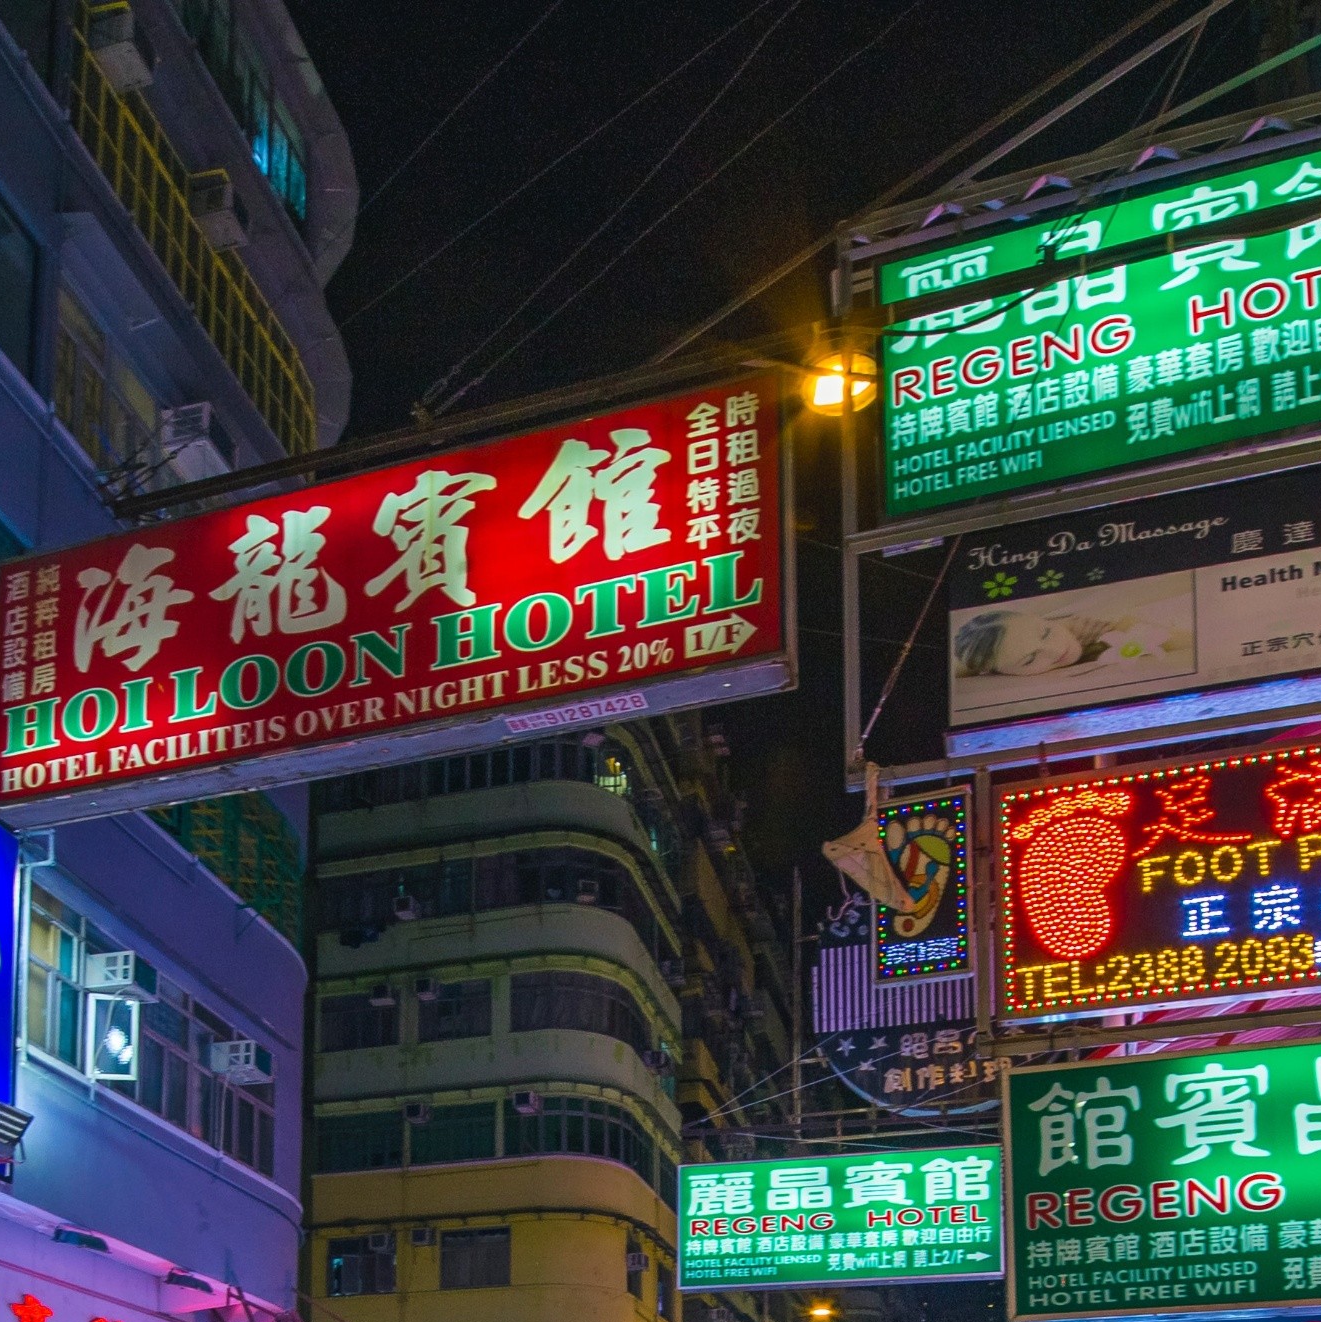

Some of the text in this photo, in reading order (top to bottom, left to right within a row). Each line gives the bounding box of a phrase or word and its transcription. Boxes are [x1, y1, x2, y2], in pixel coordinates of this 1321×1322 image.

[892, 313, 1135, 408] REGENG
[686, 401, 721, 552] 全日特平
[726, 390, 763, 545] 時租過夜
[893, 450, 1044, 500] HOTEL FREE WIFI
[894, 450, 952, 478] HOTEL
[955, 429, 1034, 465] FACILITY
[73, 427, 672, 675] 海龍賓館
[1048, 531, 1093, 557] Da
[1098, 513, 1231, 548] Massage
[1220, 563, 1304, 593] Health
[0, 570, 31, 703] 酒店設備
[1, 551, 765, 757] HOI LOON HOTEL
[32, 563, 60, 696] 純粹租房
[688, 620, 745, 659] 1/F
[0, 637, 675, 794] HOTEL FACILITEIS OVER NIGHT LESS 20%
[1137, 840, 1280, 893] FOOT
[685, 1155, 993, 1218] 麗晶賓館
[1027, 1171, 1284, 1231] REGENG
[690, 1204, 988, 1237] REGENG HOTEL
[1027, 1233, 1140, 1269] 持牌賓館
[1149, 1223, 1269, 1261] 酒店設備
[685, 1258, 722, 1268] HOTEL
[724, 1256, 773, 1266] FACILITY
[685, 1267, 777, 1279] HOTEL FREE WIFI
[1028, 1260, 1257, 1291] HOTEL FACILITY LIENSED
[1029, 1279, 1257, 1307] HOTEL FREE WIFI
